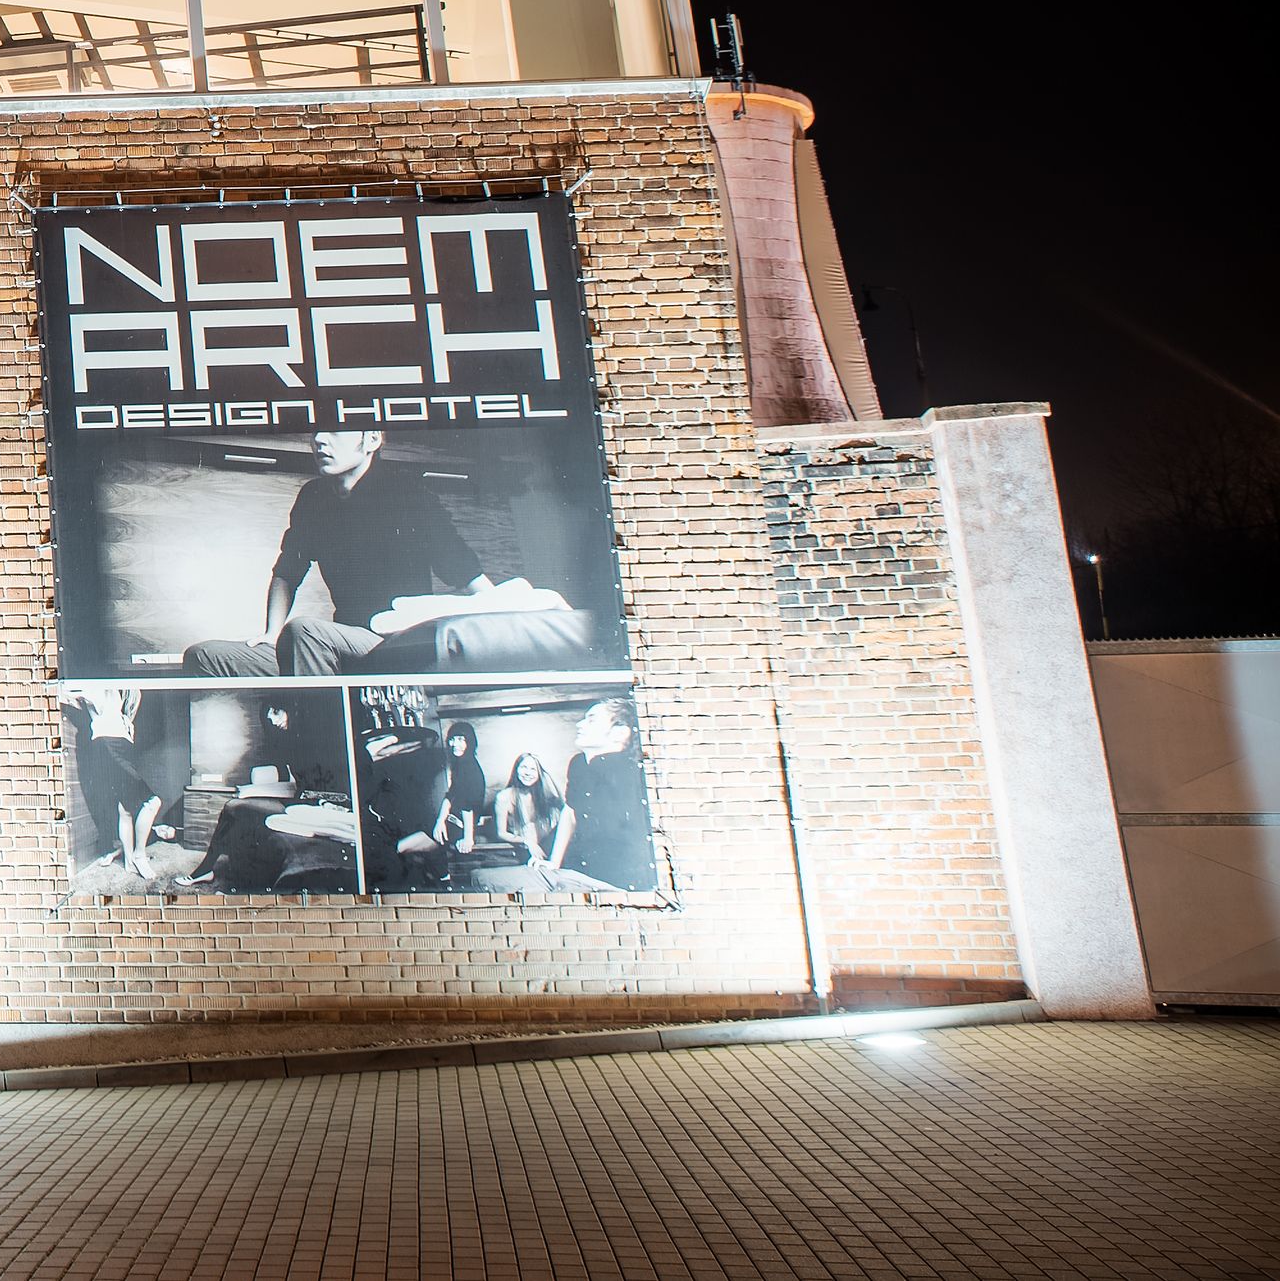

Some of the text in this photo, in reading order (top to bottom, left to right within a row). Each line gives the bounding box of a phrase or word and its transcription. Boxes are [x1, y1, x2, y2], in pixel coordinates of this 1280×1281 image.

[64, 212, 548, 305] NOEM
[69, 299, 560, 392] ARCH
[75, 394, 567, 430] DESIGN HOTEL
